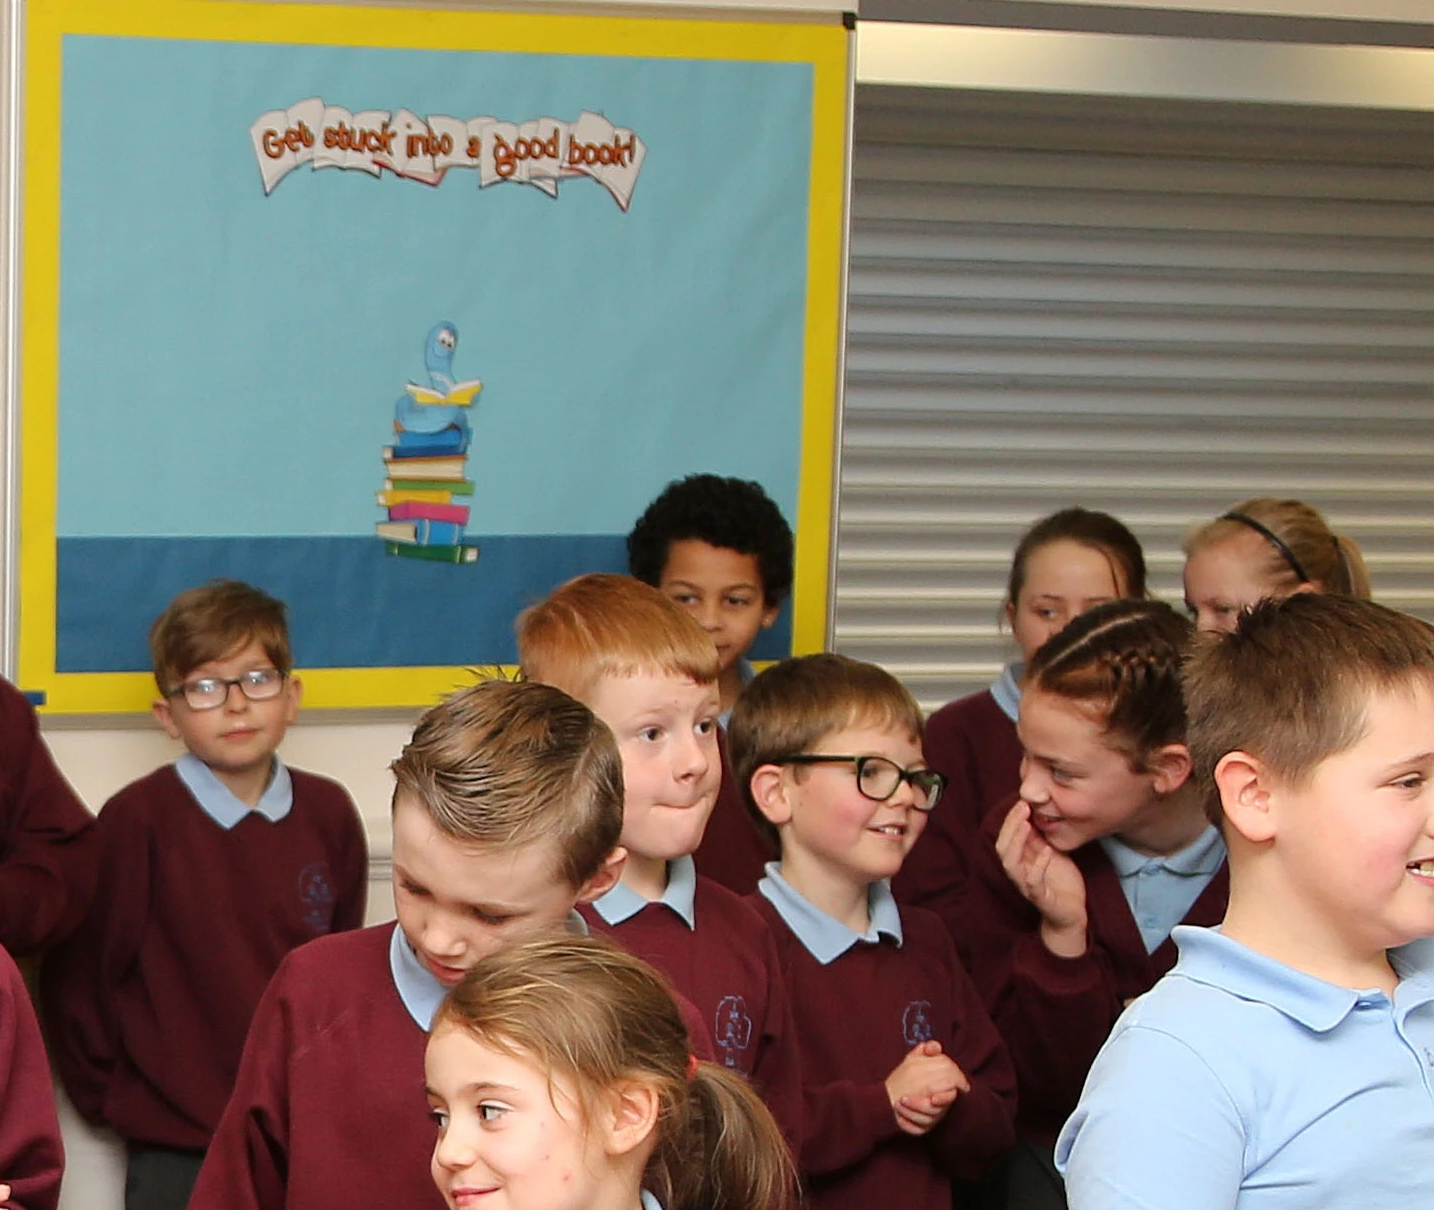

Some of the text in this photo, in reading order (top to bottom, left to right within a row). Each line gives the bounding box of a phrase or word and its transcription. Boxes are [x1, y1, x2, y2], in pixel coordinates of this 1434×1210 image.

[263, 120, 315, 159] Get
[324, 120, 397, 157] stuck
[406, 122, 454, 158] into
[467, 135, 481, 158] a
[493, 127, 560, 178] good
